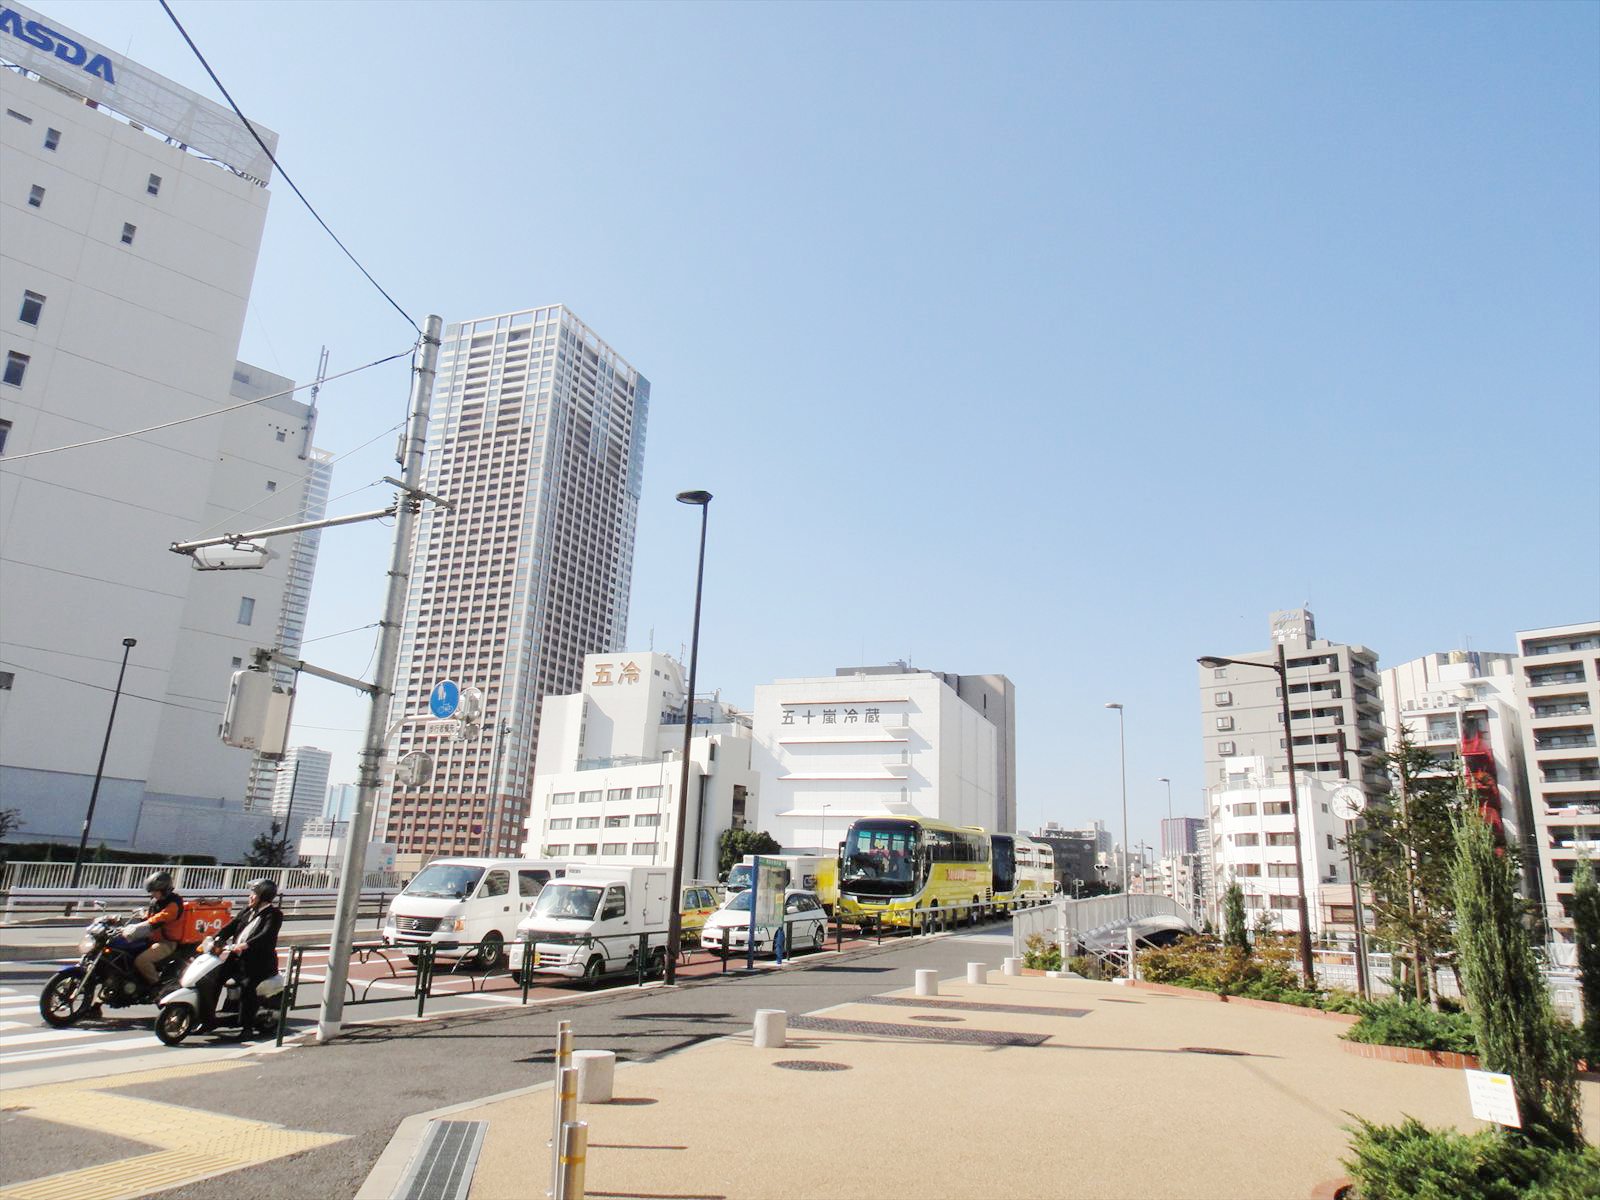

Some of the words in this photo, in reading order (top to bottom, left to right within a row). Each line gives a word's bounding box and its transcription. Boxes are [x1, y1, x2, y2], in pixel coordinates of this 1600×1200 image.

[592, 660, 641, 686] 五冷
[781, 708, 880, 725] 五十嵐冷蔵
